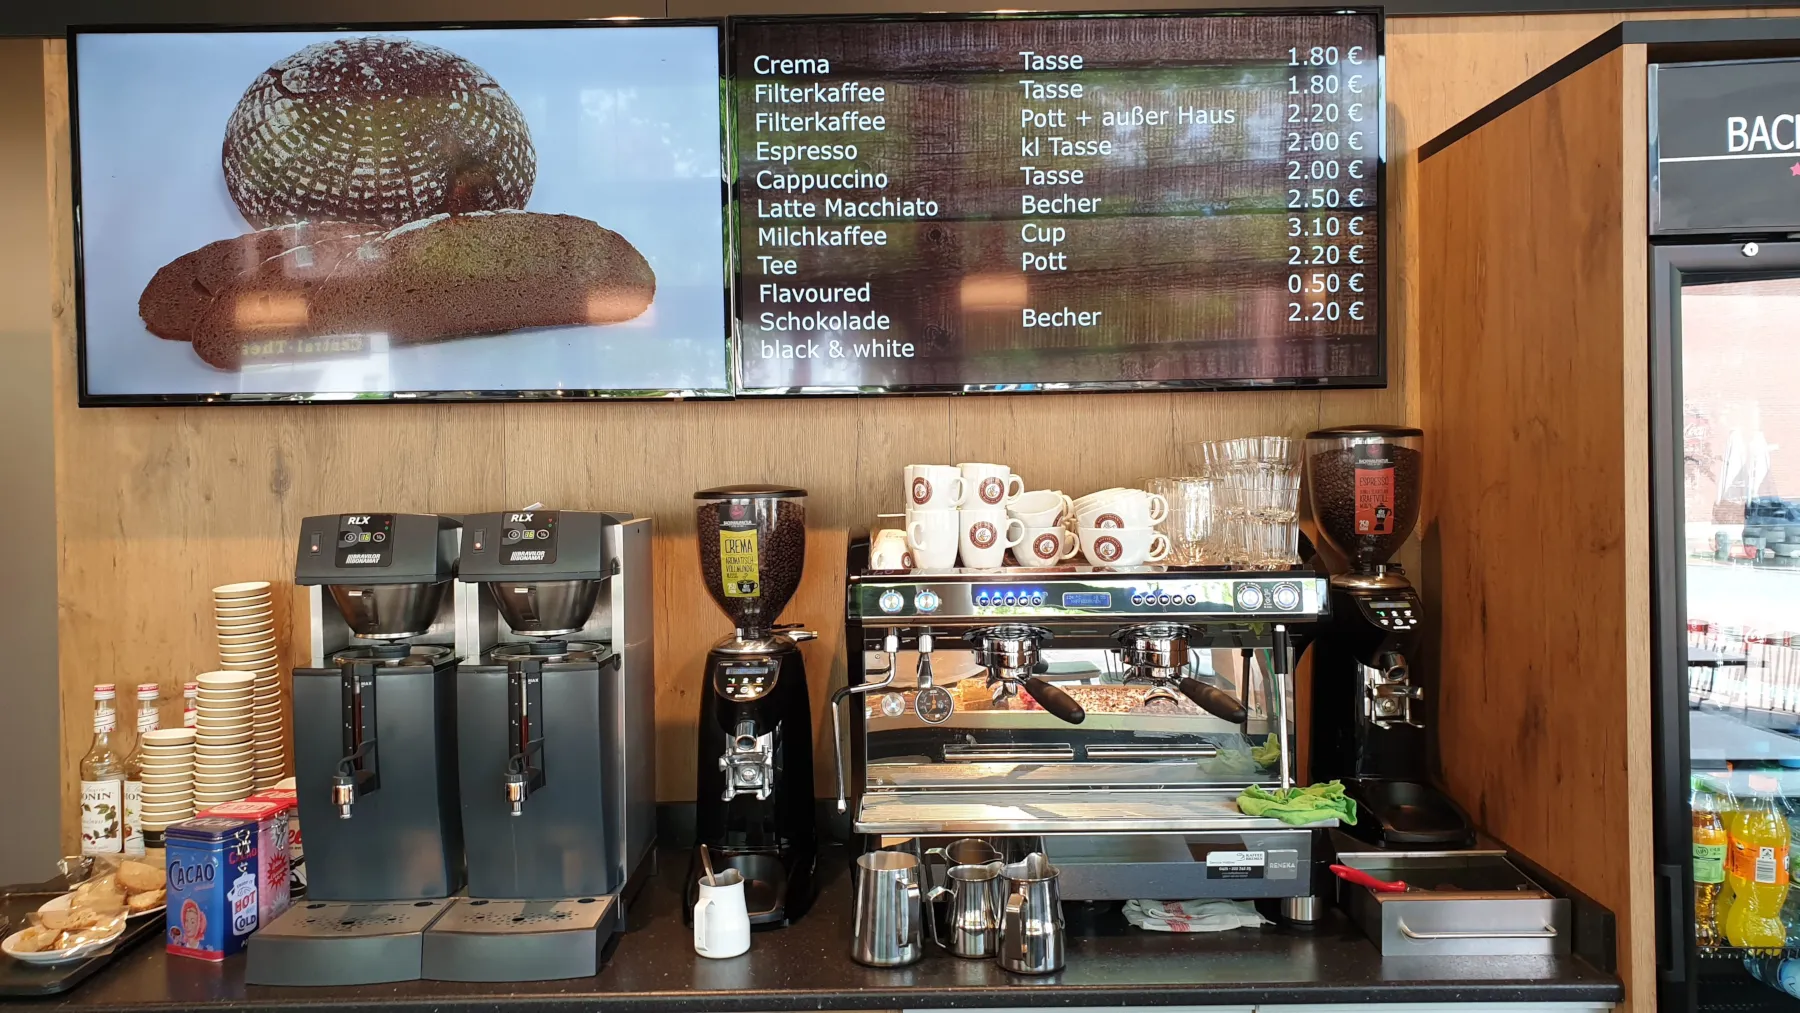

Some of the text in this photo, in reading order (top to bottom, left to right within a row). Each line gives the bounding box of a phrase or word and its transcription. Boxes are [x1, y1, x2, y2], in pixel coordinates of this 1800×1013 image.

[753, 55, 829, 75] Crema
[1018, 51, 1083, 71] Tasse
[1288, 45, 1362, 66] 1.80 €
[755, 84, 885, 103] Filterkaffee
[1019, 80, 1084, 100] Tasse
[1288, 74, 1362, 95] 1.80 €
[755, 110, 886, 132] Filterkaffee
[1021, 106, 1235, 128] Pott + außer Haus
[1287, 104, 1362, 123] 2.20 €
[1021, 136, 1111, 157] kl Tasse
[1288, 130, 1364, 152] 2.00 €
[756, 141, 858, 165] Espresso
[1019, 166, 1084, 186] Tasse
[1288, 159, 1364, 180] 2.00 €
[756, 169, 888, 194] Cappuccino
[757, 196, 939, 218] Latte Macchiato
[1022, 193, 1102, 214] Becher
[1288, 188, 1364, 208] 2.50 €
[758, 225, 887, 247] Milchkaffee
[1021, 223, 1066, 247] Cup
[1288, 216, 1364, 237] 3.10 €
[756, 255, 797, 275] Tee
[1022, 251, 1067, 271] Pott
[1288, 244, 1364, 265] 2.20 €
[760, 282, 870, 303] Flavoured
[1288, 272, 1364, 294] 0.50 €
[760, 310, 890, 331] Schokolade
[1022, 309, 1102, 328] Becher
[1288, 301, 1364, 322] 2.20 €
[761, 339, 915, 359] black & white
[347, 516, 371, 525] RLX
[510, 513, 534, 523] RLX
[724, 538, 754, 554] CREMA
[228, 847, 258, 866] CAO
[168, 860, 216, 892] CACAO
[234, 889, 257, 915] HOT
[234, 914, 257, 932] COLD
